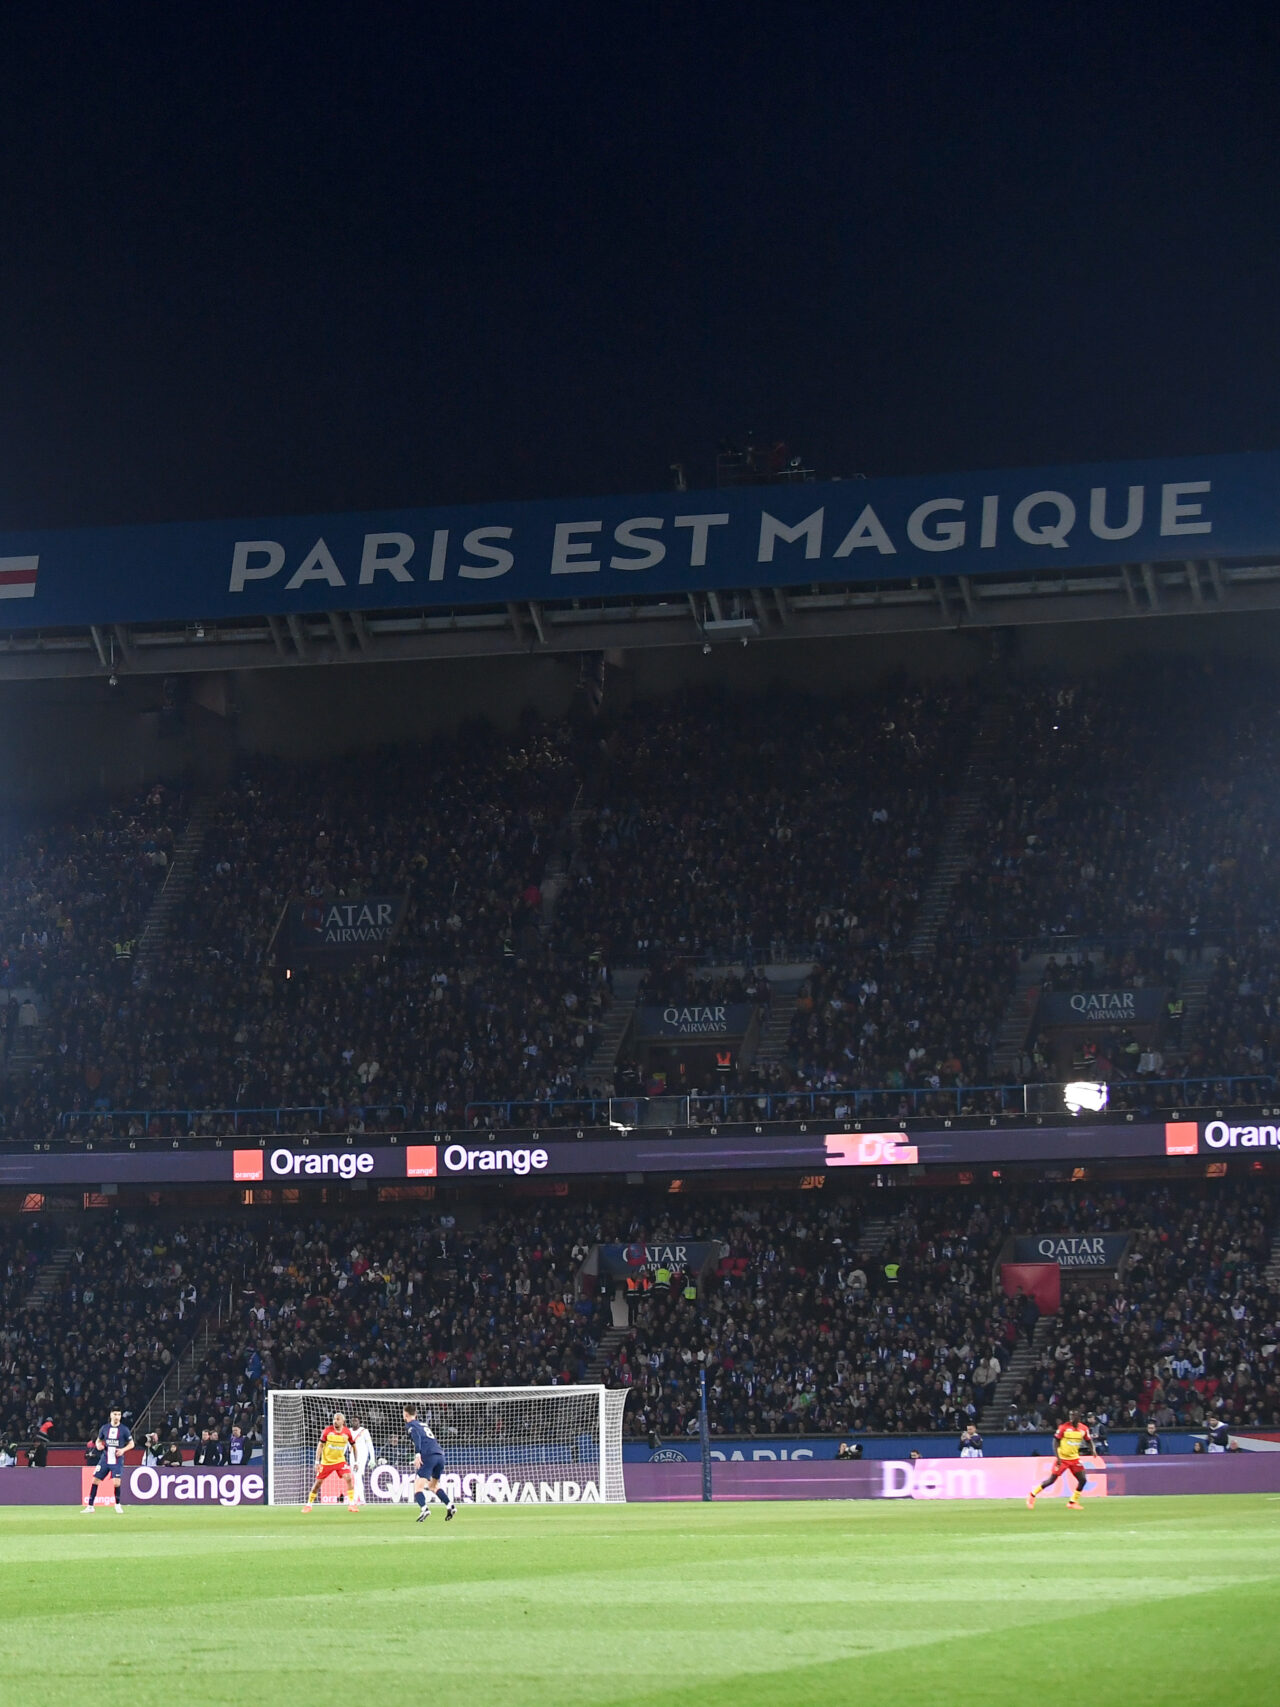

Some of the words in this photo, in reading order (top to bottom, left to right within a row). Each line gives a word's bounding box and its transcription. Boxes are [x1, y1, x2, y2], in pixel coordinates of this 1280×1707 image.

[229, 526, 514, 592] PARIS
[551, 513, 729, 574] EST
[758, 481, 1212, 562] MAGIQUE
[320, 903, 392, 928] ATAR
[1070, 993, 1134, 1012] QATAR
[664, 1007, 725, 1026] QATAR
[1087, 1009, 1135, 1019] AIRWAYS
[680, 1022, 726, 1032] AIRWAYS
[1205, 1121, 1280, 1150] Oran
[270, 1149, 374, 1179] Orange
[444, 1145, 548, 1175] Orange
[234, 1170, 262, 1179] orange
[1039, 1238, 1105, 1258] QATAR
[1057, 1255, 1106, 1265] AIRWAYS
[423, 1426, 435, 1440] 8
[654, 1452, 682, 1462] PARIS
[130, 1466, 263, 1506] Orange
[370, 1464, 508, 1504] Ornge
